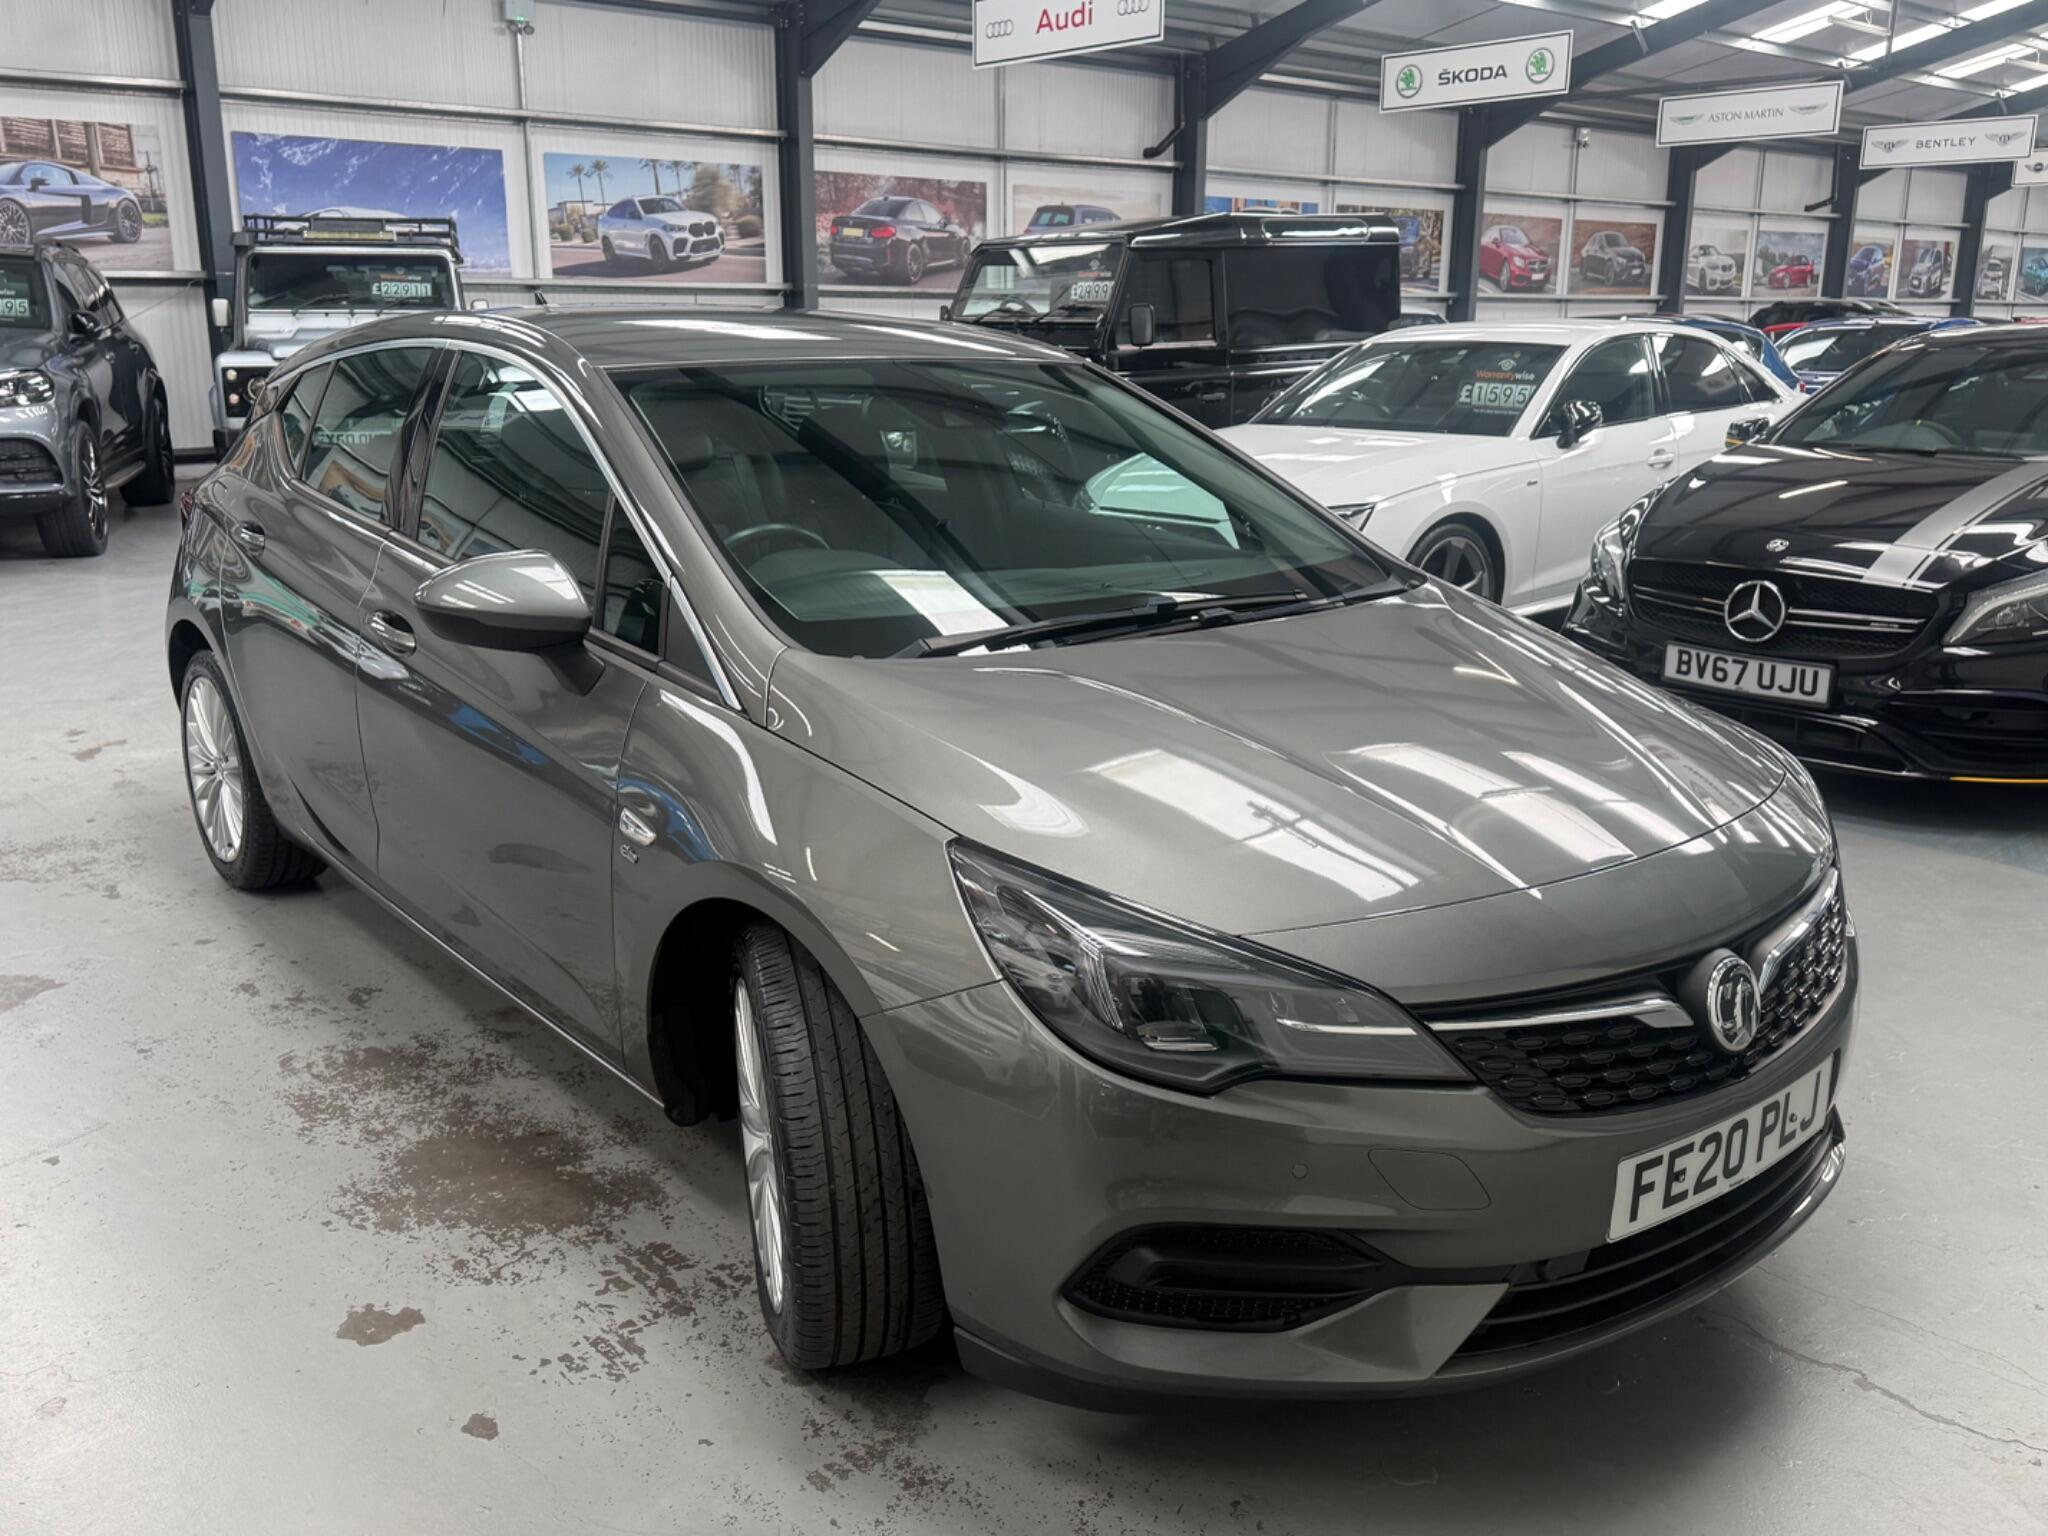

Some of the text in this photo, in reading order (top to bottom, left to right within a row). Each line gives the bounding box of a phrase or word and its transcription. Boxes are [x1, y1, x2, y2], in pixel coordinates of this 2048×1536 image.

[1036, 1, 1093, 34] Audi
[1438, 65, 1508, 86] ŠKODA
[1708, 108, 1784, 122] ASTON MARTIN
[1915, 137, 1976, 149] BENTLEY
[371, 282, 432, 297] £22911
[1459, 384, 1532, 404] £1595
[1676, 649, 1819, 696] BV67 UJU
[1629, 1070, 1822, 1223] FE20 PLJ
